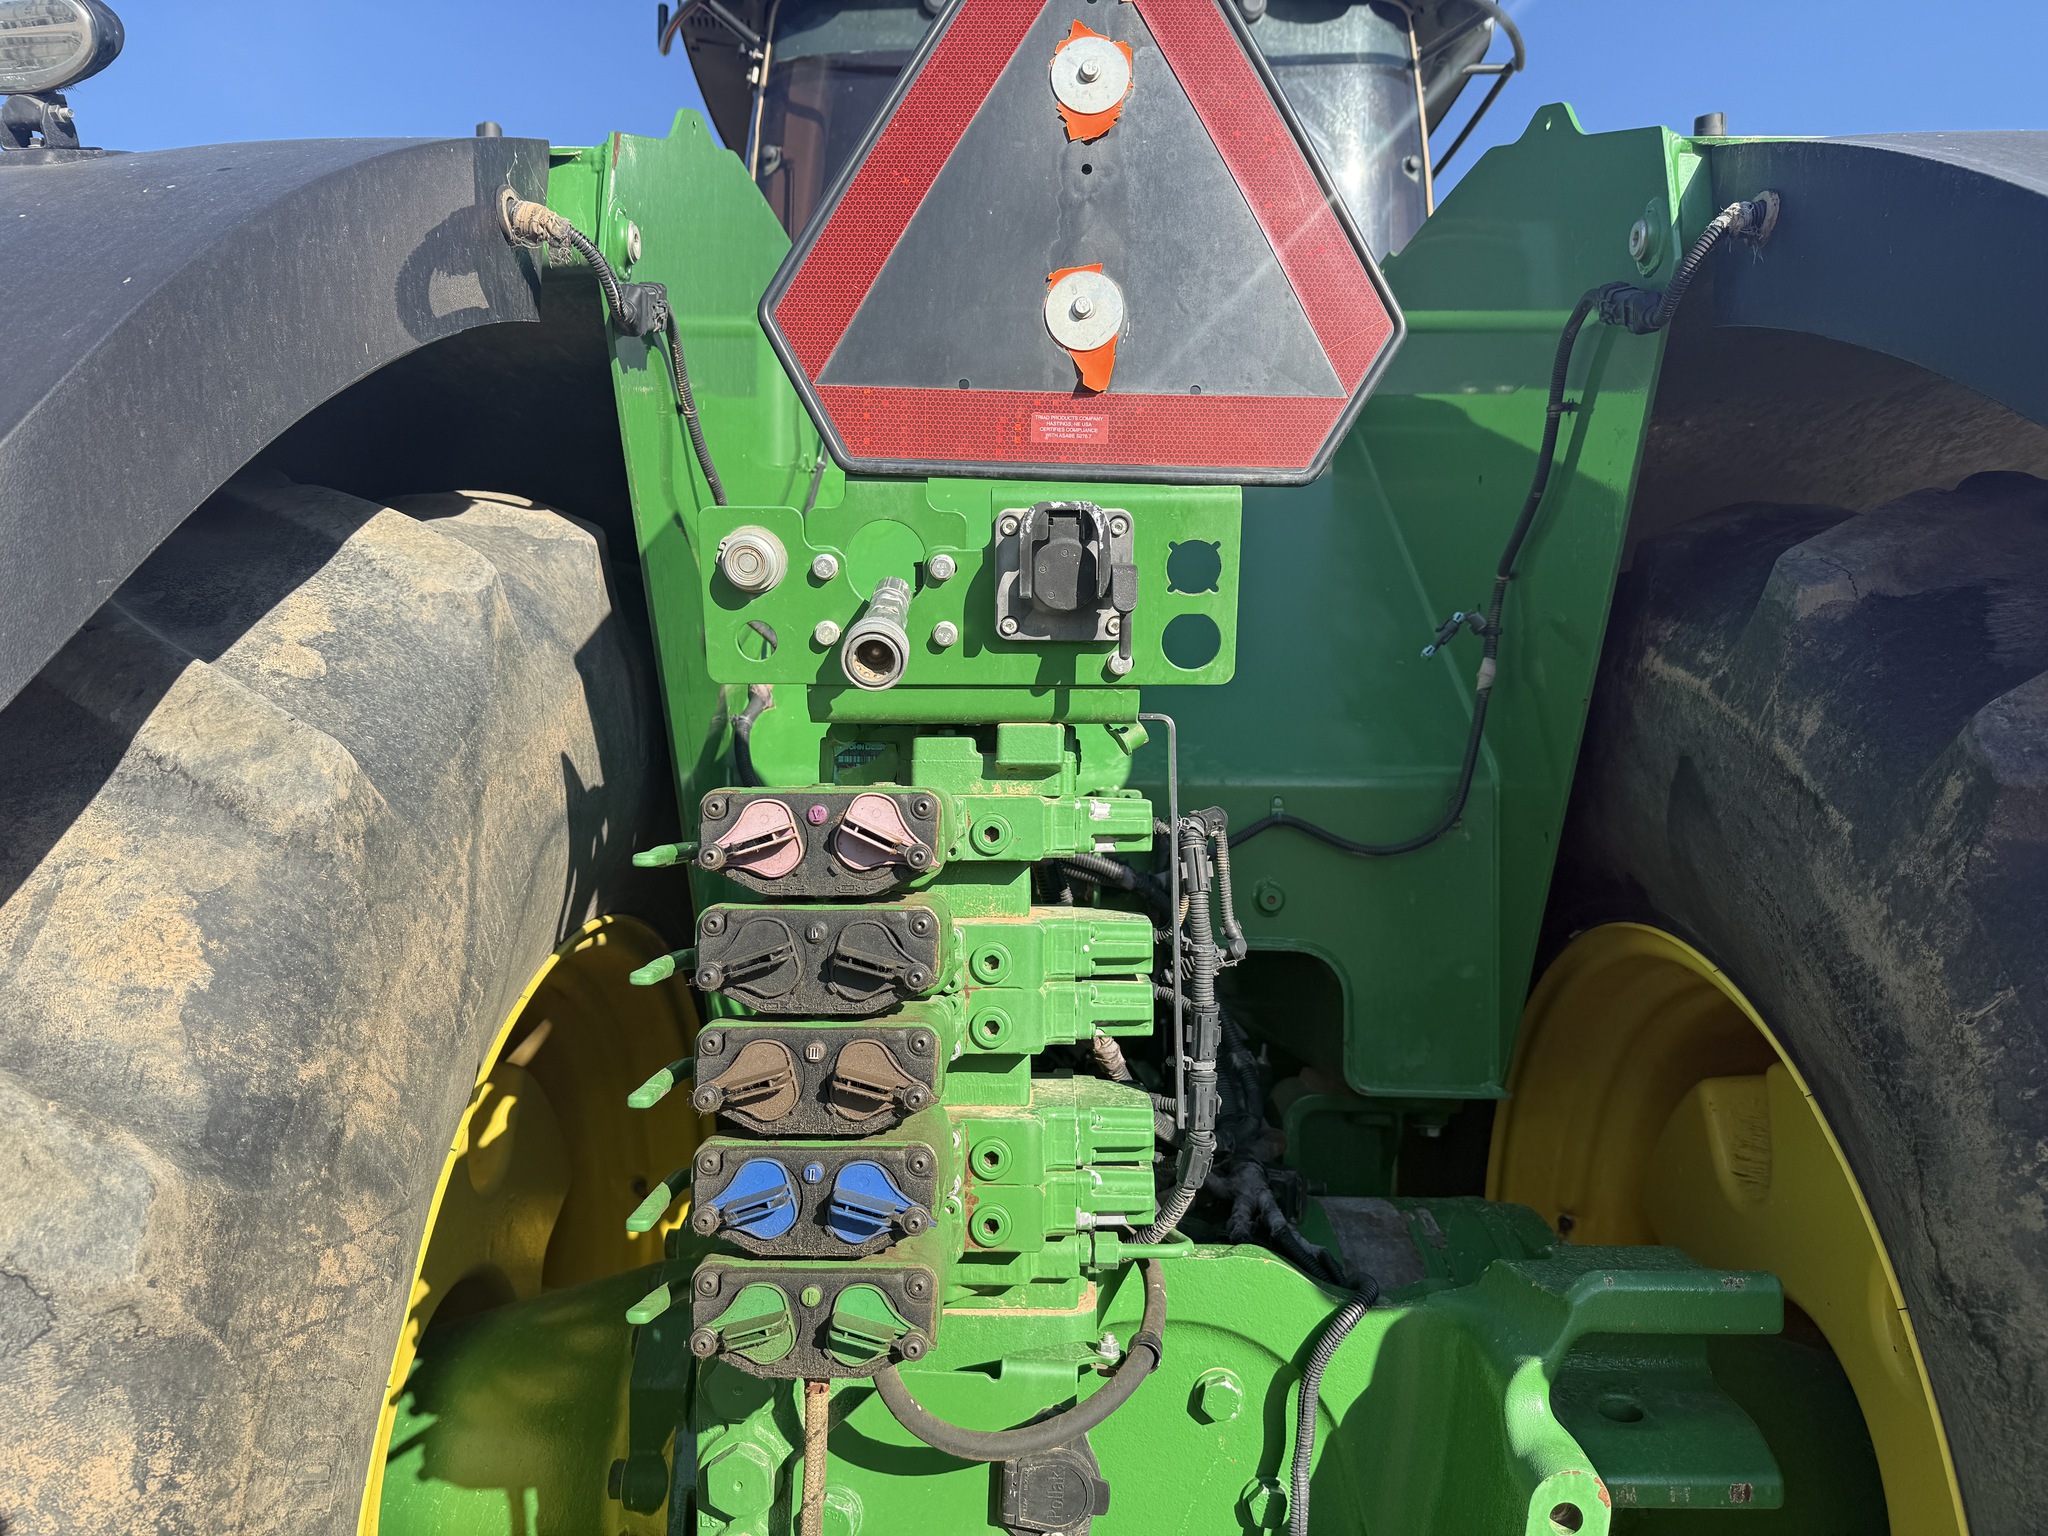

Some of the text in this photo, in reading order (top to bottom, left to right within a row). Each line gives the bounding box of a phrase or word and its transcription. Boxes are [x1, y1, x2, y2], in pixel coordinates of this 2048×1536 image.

[811, 809, 823, 822] V
[809, 1046, 821, 1060] III
[808, 1168, 816, 1181] II
[1045, 1470, 1066, 1522] Pollak
